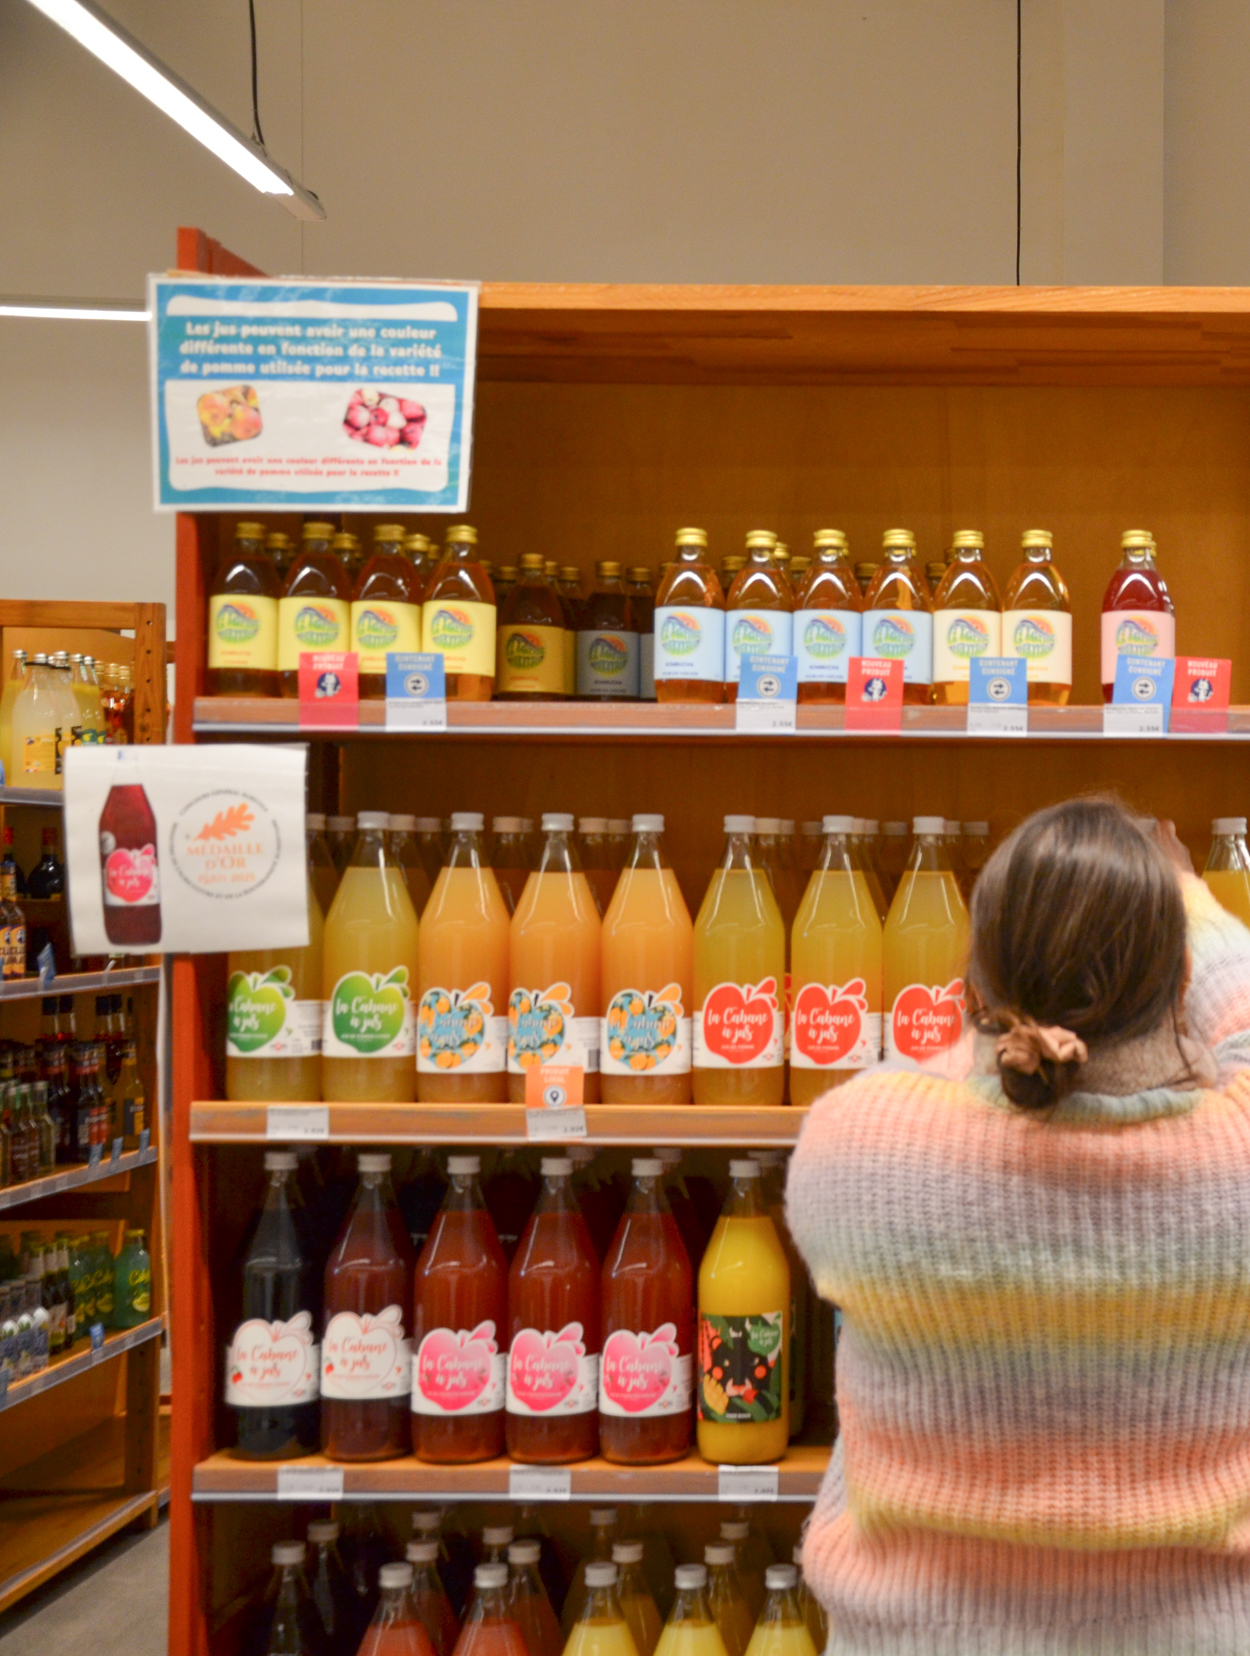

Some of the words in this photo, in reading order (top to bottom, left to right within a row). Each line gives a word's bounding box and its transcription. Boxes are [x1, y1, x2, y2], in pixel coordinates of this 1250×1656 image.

[186, 320, 210, 336] Les
[212, 320, 237, 339] jus
[241, 324, 302, 339] peuvent
[306, 323, 345, 338] avoir
[348, 327, 376, 339] une
[380, 325, 437, 340] couleur
[180, 339, 254, 355] différente
[257, 344, 276, 356] en
[282, 341, 344, 357] fonction
[348, 343, 367, 357] de
[370, 344, 385, 357] la
[389, 343, 442, 359] variété
[180, 359, 198, 374] de
[202, 362, 256, 377] pomme
[315, 364, 350, 378] pour
[354, 362, 369, 376] la
[373, 364, 426, 377] recette
[176, 457, 188, 465] Les
[206, 458, 239, 466] peuvent
[242, 456, 264, 464] avoir
[286, 457, 318, 465] couleur
[322, 456, 365, 465] différente
[381, 457, 418, 466] fonction
[420, 458, 432, 466] de
[215, 467, 244, 476] variété
[260, 469, 291, 477] pomme
[326, 470, 346, 478] pour
[350, 468, 358, 476] la
[360, 469, 390, 477] recette
[750, 656, 789, 665] CONTENANT
[862, 660, 892, 668] NOUVEAU
[1127, 657, 1166, 668] CONTENANT
[1188, 660, 1218, 668] NOUVEAU
[752, 664, 786, 674] CONSIGNÉ
[862, 668, 890, 676] PRODUIT
[982, 666, 1016, 676] CONSIGNÉ
[1128, 666, 1162, 676] CONSIGNÉ
[1188, 668, 1216, 676] PRODUIT
[187, 842, 264, 856] MÉDAILLE
[205, 856, 246, 870] D'OR
[234, 995, 276, 1014] Cabane
[336, 998, 348, 1016] la
[351, 996, 398, 1015] Cabane
[360, 1015, 383, 1033] jus
[708, 1008, 720, 1026] la
[723, 1008, 768, 1025] Cabane
[798, 1009, 808, 1026] la
[809, 1008, 855, 1026] Cabane
[897, 1010, 909, 1026] la
[731, 1025, 754, 1044] jus
[818, 1026, 839, 1044] jus
[920, 1026, 942, 1044] jus
[251, 1346, 298, 1362] Cabane
[342, 1338, 388, 1354] Cabane
[422, 1354, 434, 1370] la
[437, 1354, 484, 1370] Cabane
[512, 1355, 524, 1372] la
[525, 1355, 570, 1373] Cabane
[606, 1356, 617, 1373] la
[619, 1356, 664, 1374] Cabane
[446, 1372, 467, 1390] jus
[534, 1374, 554, 1391] jus
[627, 1374, 648, 1392] jus
